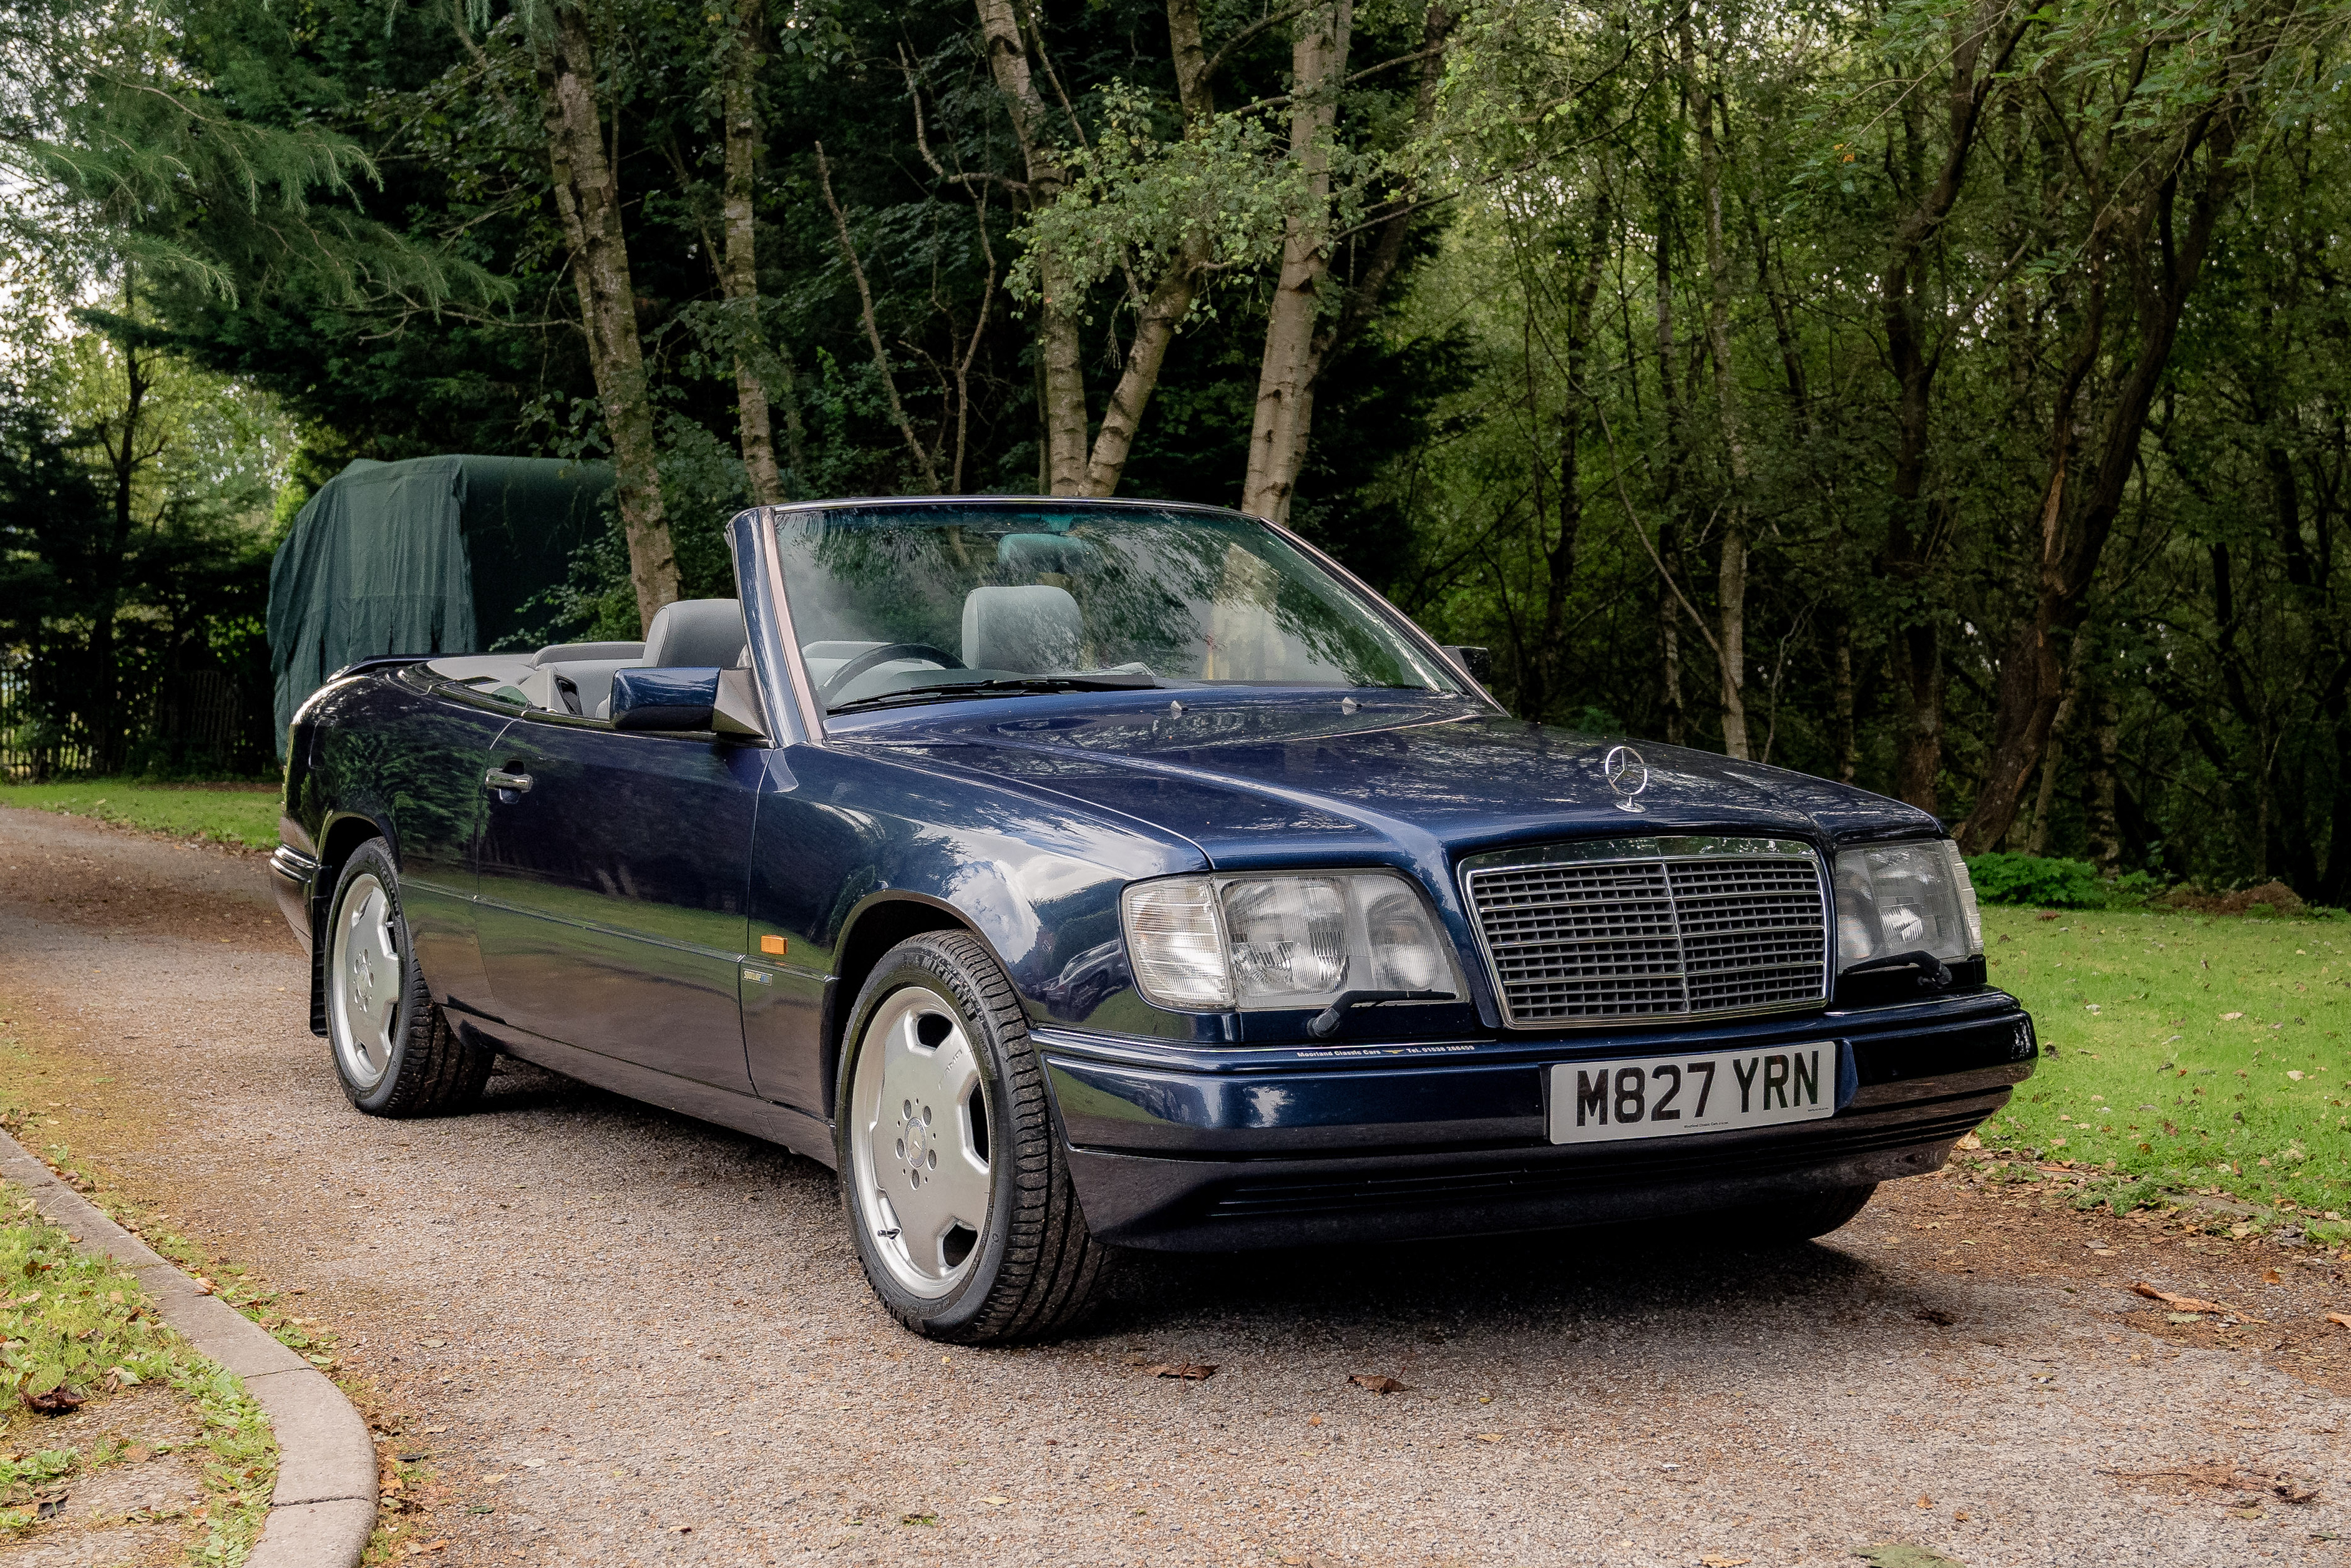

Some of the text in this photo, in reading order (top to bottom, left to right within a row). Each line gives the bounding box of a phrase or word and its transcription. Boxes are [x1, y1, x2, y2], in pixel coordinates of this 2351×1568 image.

[921, 957, 975, 1018] MICHELIN
[1576, 1050, 1819, 1127] M827 YRN
